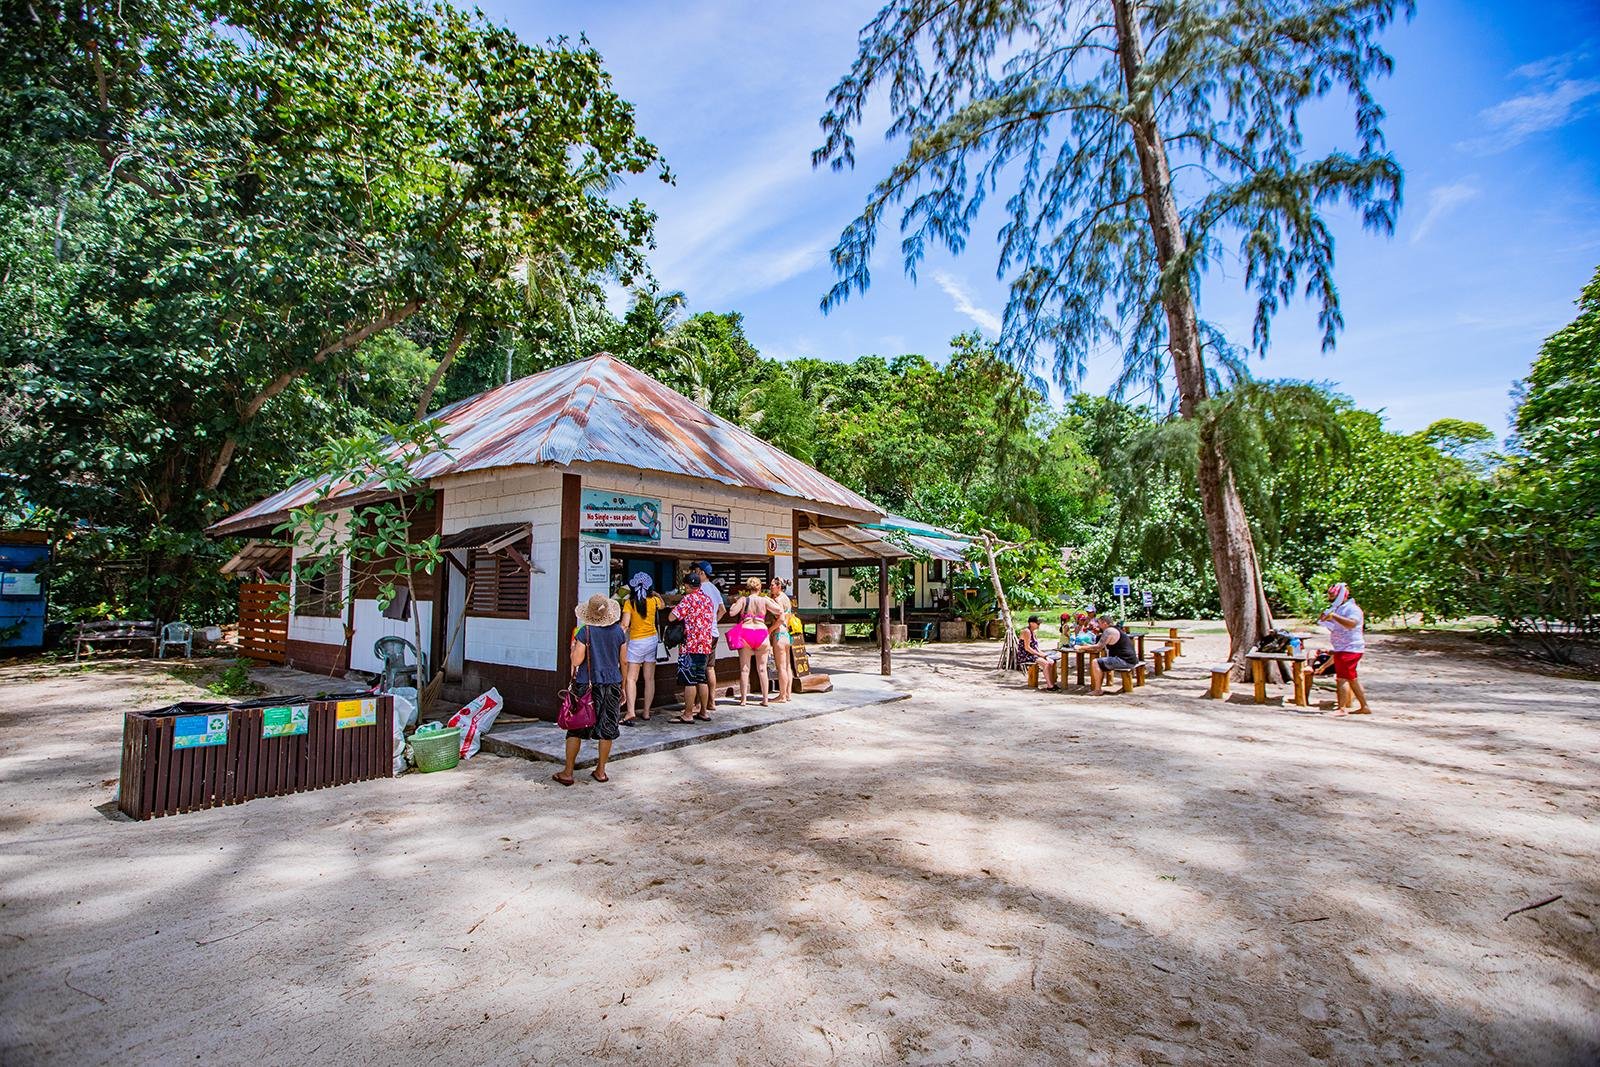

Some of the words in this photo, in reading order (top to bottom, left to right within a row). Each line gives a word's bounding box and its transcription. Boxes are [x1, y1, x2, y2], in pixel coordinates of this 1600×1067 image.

[594, 513, 609, 522] Single
[621, 514, 637, 522] plastic
[692, 528, 706, 538] FOOD
[706, 529, 728, 540] SERVICE
